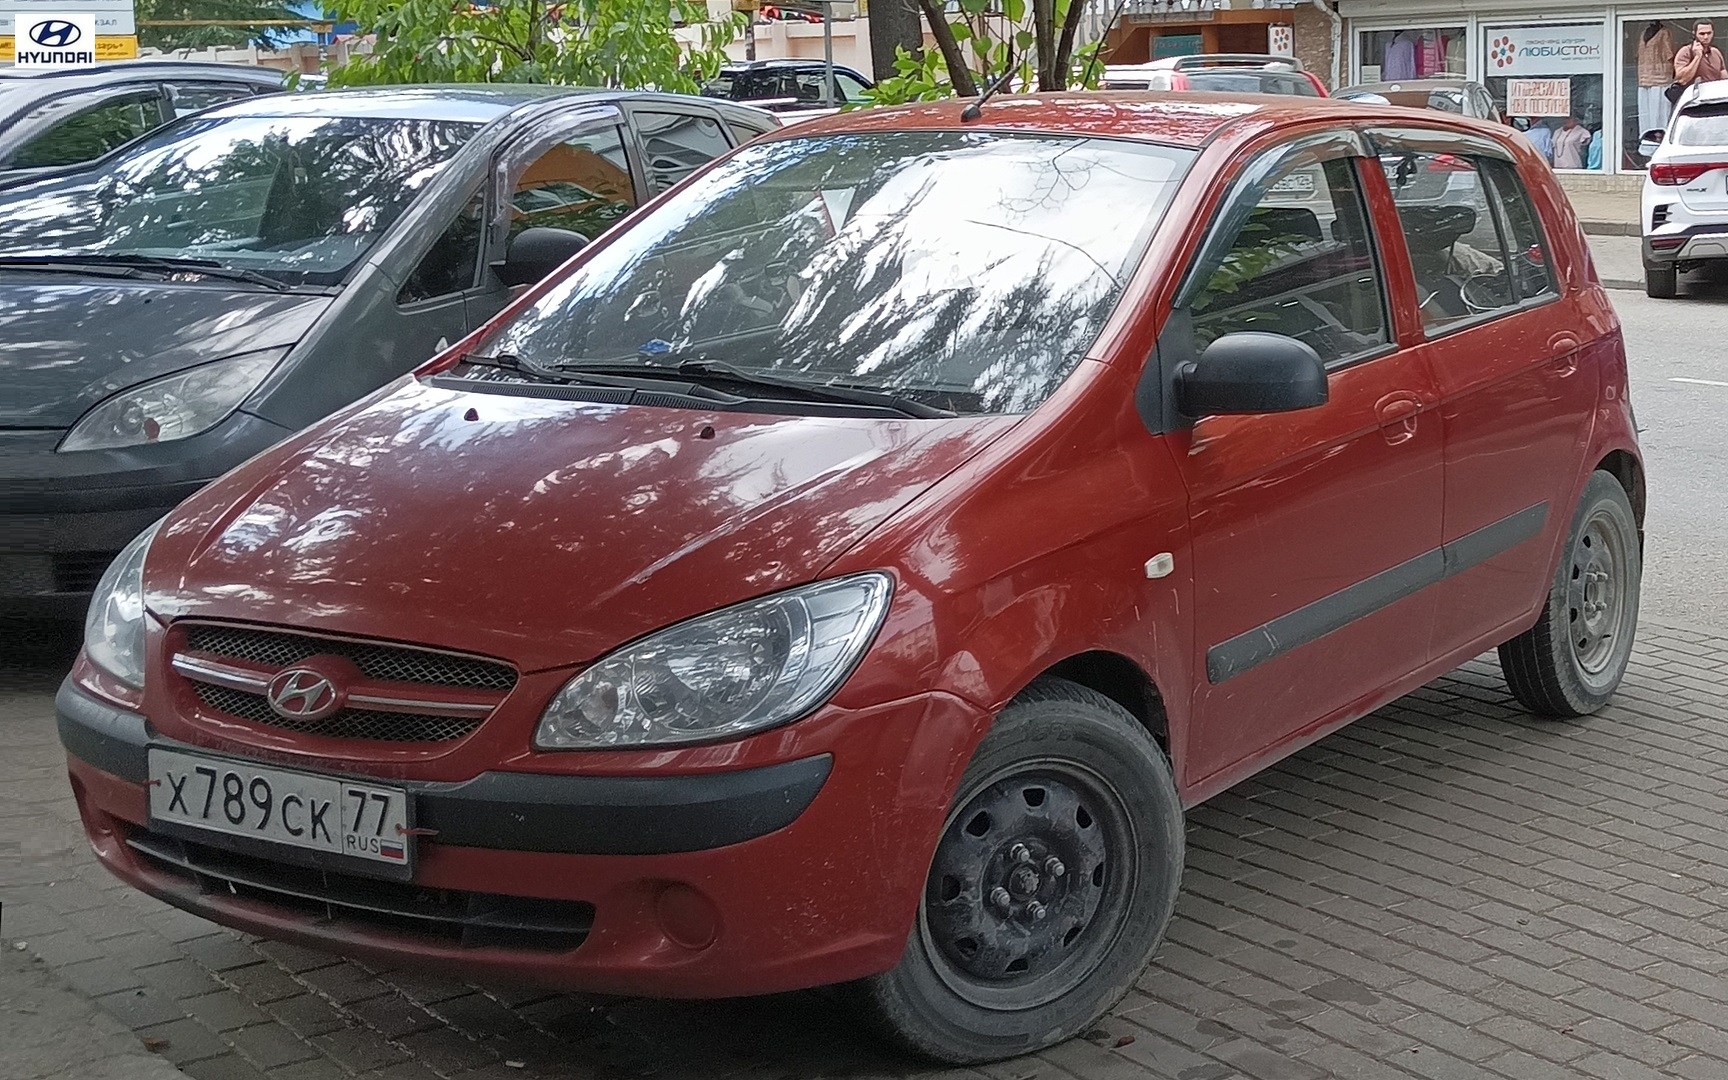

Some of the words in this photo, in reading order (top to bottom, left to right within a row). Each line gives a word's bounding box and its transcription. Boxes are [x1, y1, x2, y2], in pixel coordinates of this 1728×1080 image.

[1518, 44, 1600, 57] ЛЮБИСТОК
[348, 789, 392, 837] 77
[346, 833, 380, 854] RUS
